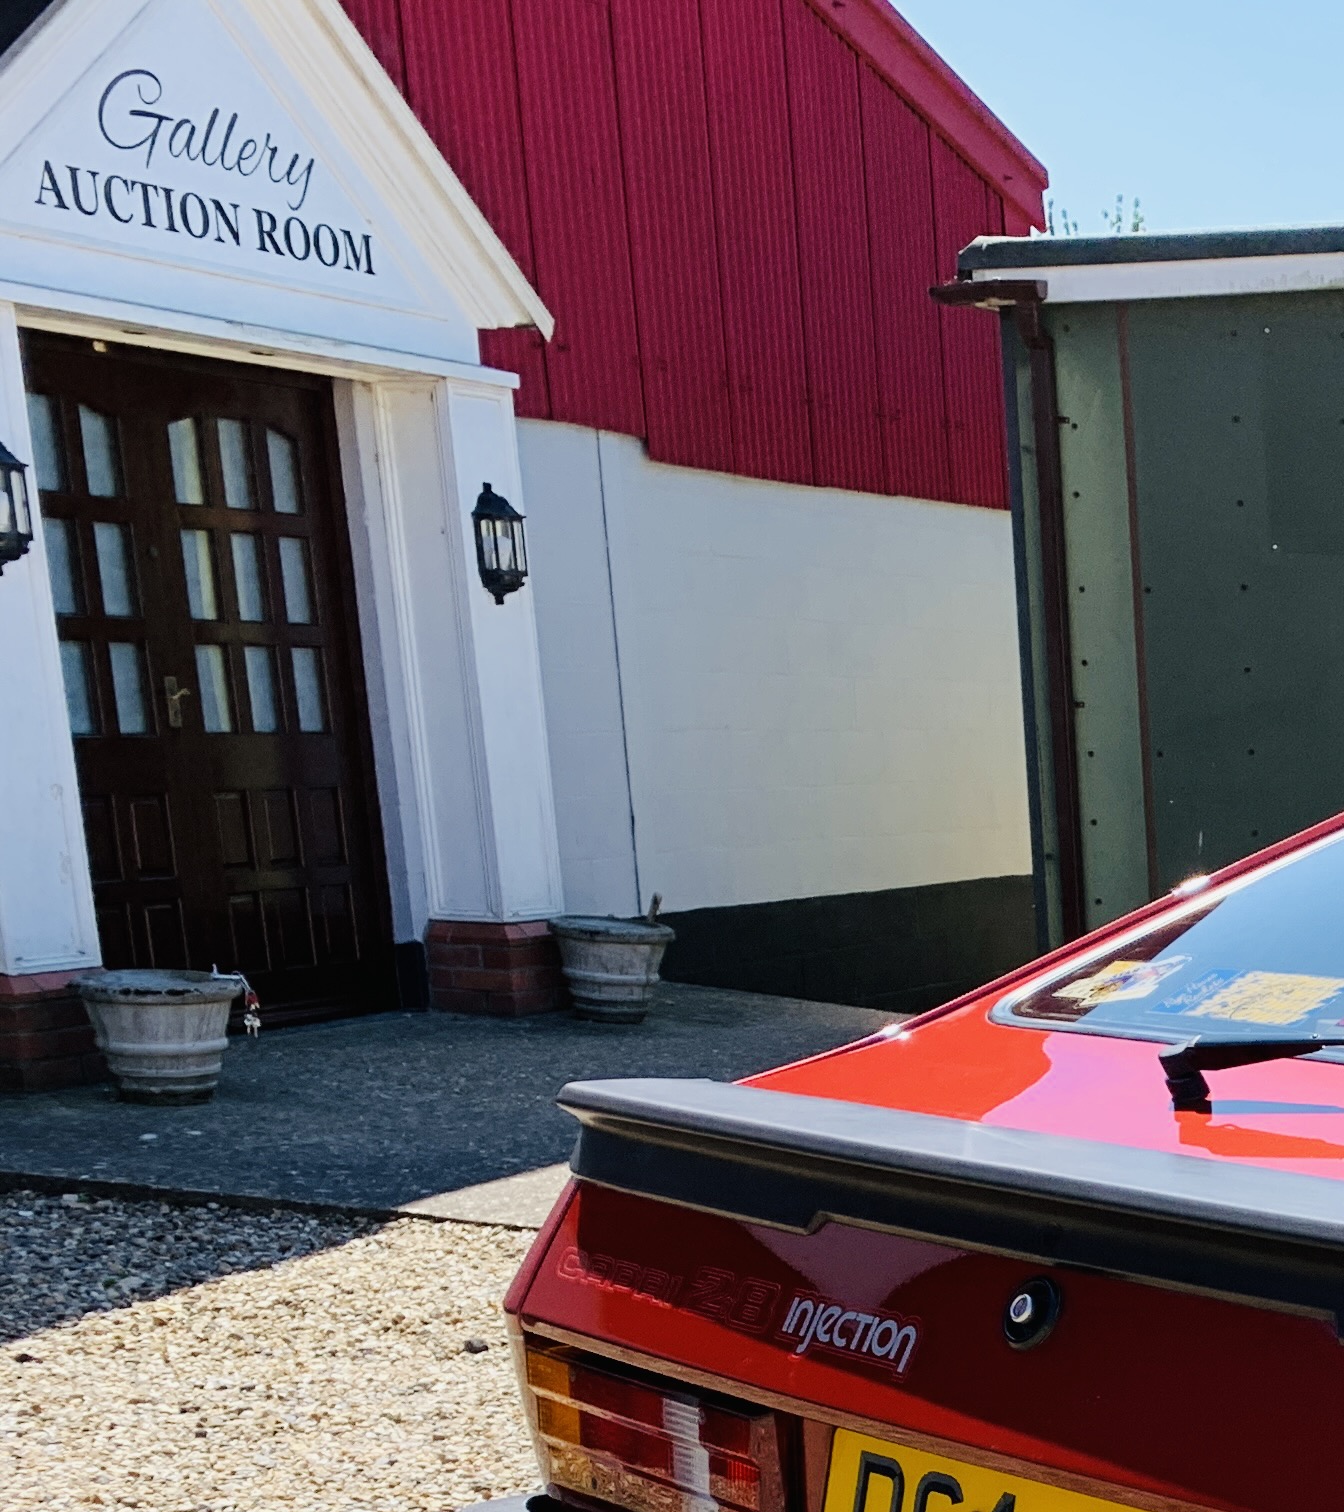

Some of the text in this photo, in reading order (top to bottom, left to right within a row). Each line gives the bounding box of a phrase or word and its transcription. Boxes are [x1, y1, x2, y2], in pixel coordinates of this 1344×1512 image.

[98, 69, 314, 211] Gallery
[34, 159, 377, 276] AUCTION ROOM
